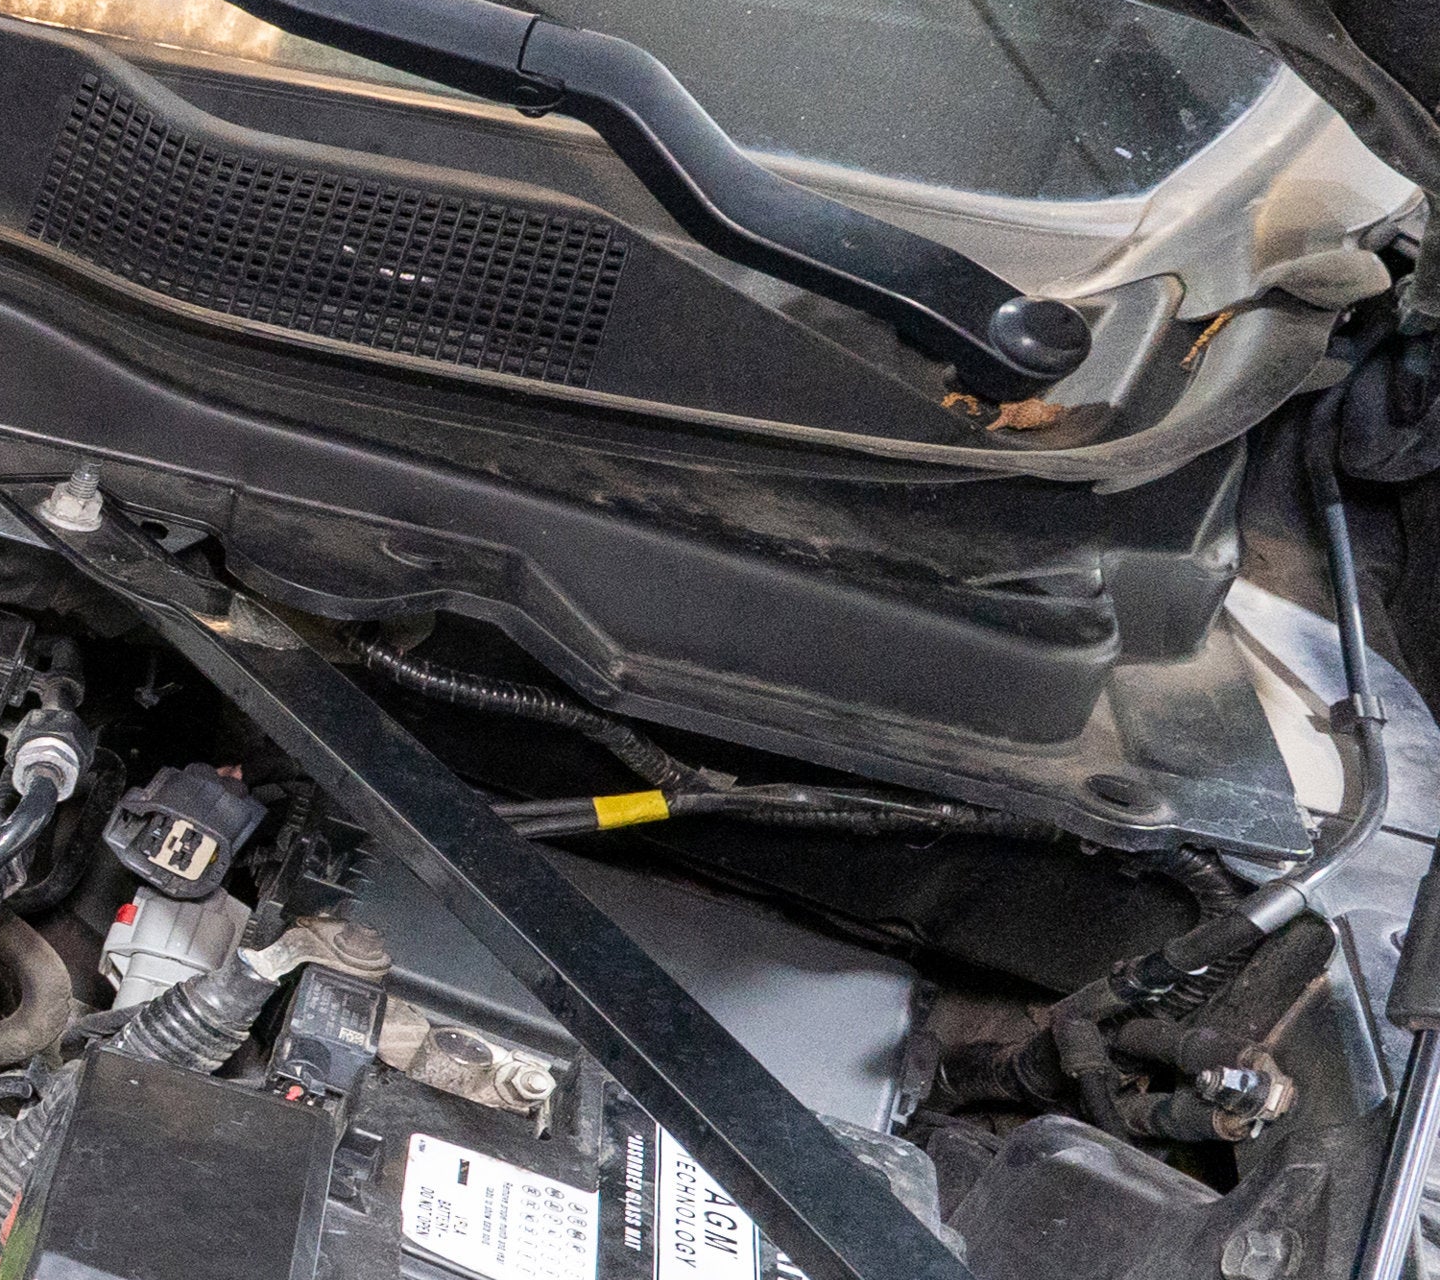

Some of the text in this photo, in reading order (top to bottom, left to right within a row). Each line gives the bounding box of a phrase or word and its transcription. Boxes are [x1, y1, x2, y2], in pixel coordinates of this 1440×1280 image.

[419, 1185, 434, 1200] DO
[418, 1197, 433, 1217] NOT
[624, 1190, 642, 1226] GLASS
[676, 1153, 697, 1269] ECHNOLOGY
[623, 1226, 641, 1251] MAT
